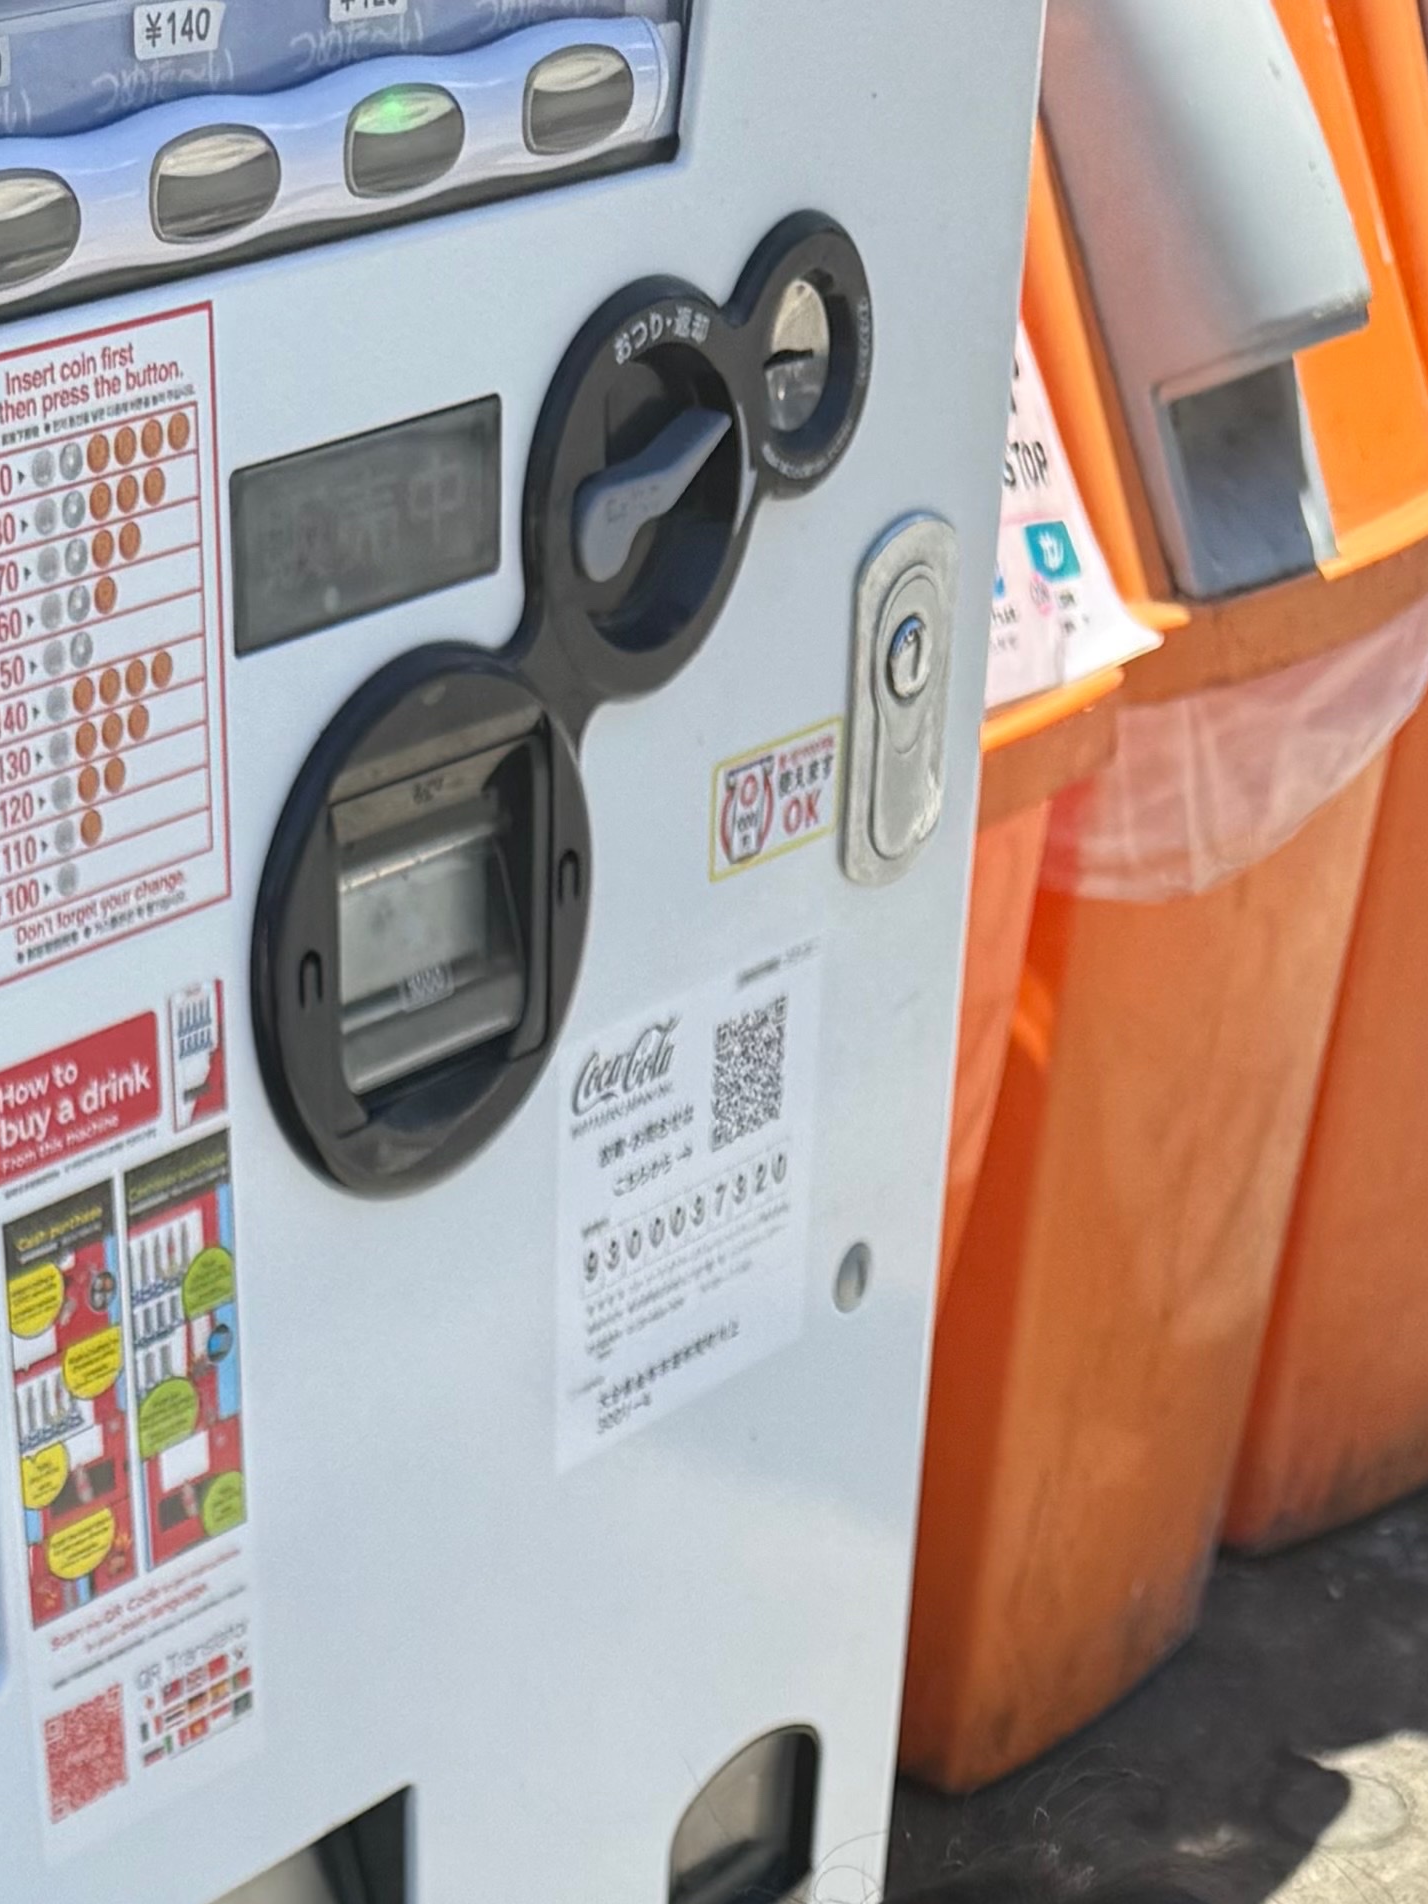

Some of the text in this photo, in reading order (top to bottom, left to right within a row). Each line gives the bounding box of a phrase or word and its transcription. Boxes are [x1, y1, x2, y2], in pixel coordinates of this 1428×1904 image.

[144, 6, 211, 48] ¥140
[5, 342, 134, 396] Insert coin first
[41, 384, 90, 421] press
[93, 371, 122, 399] the
[124, 360, 184, 391] button.
[782, 788, 822, 836] OK
[52, 1060, 78, 1089] to
[57, 1098, 76, 1125] a
[79, 1060, 151, 1115] drink
